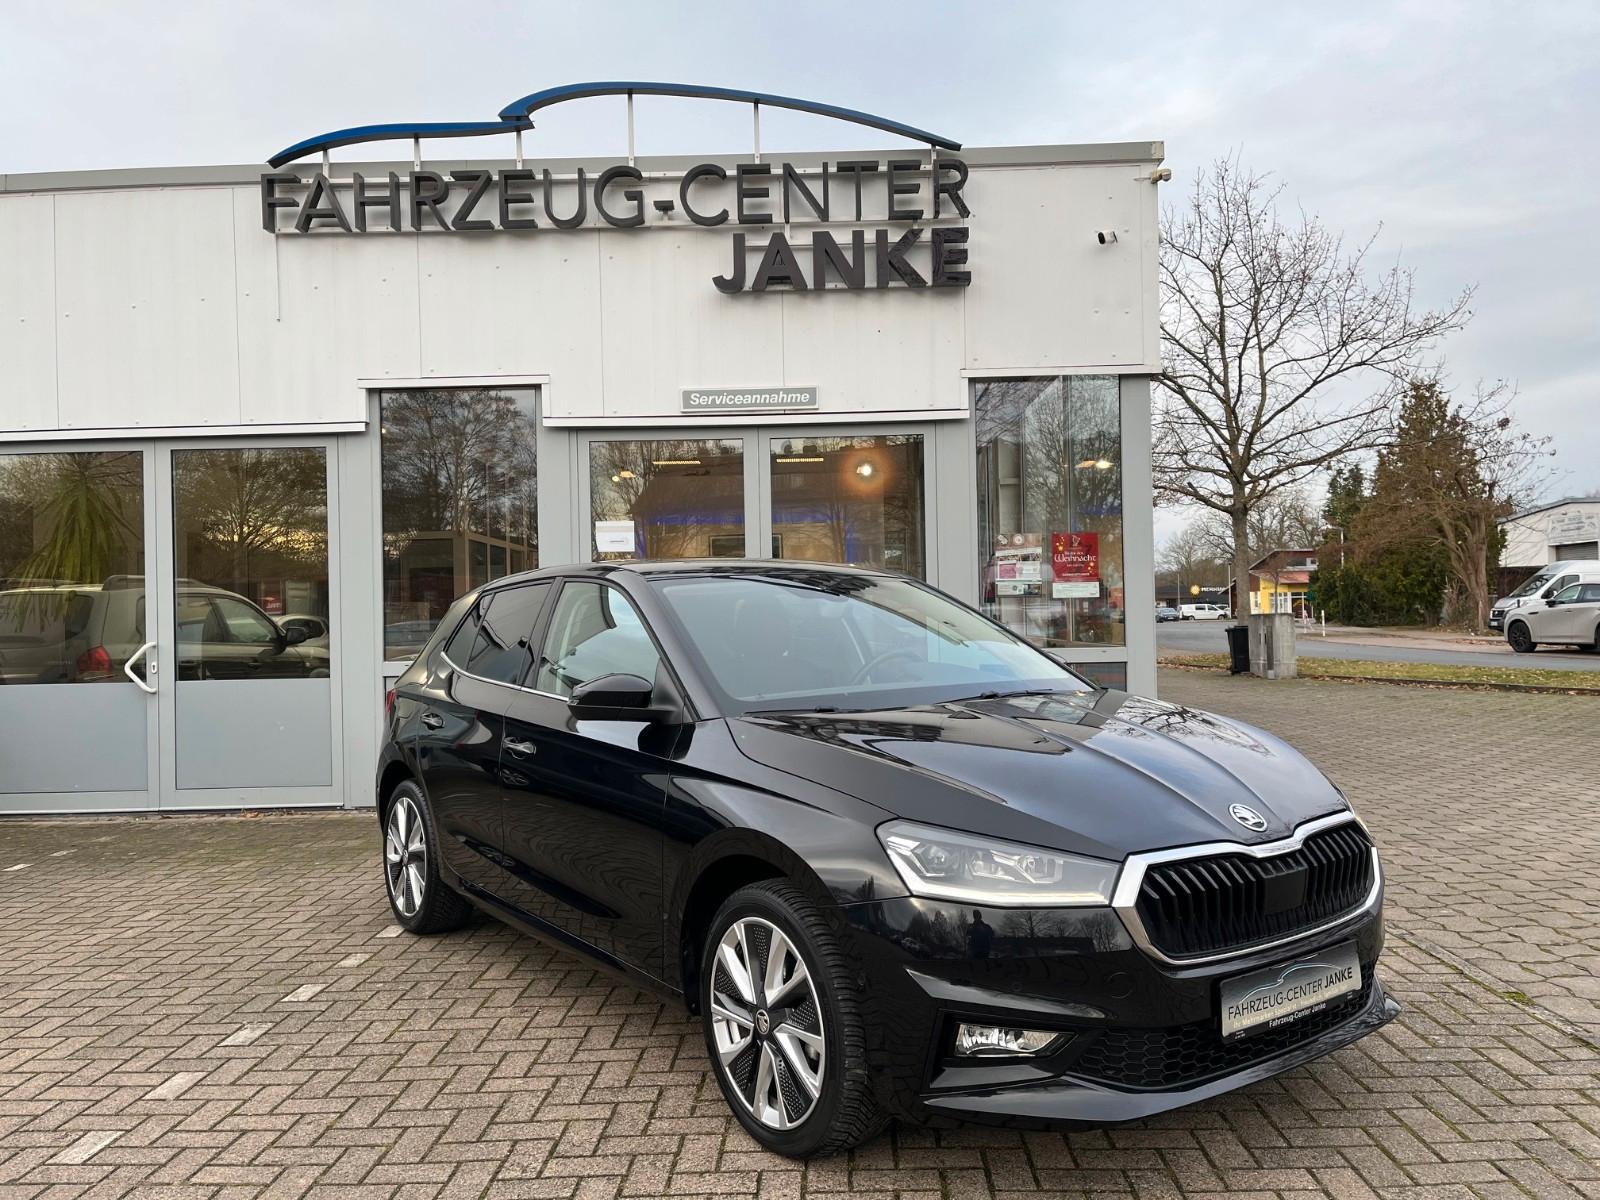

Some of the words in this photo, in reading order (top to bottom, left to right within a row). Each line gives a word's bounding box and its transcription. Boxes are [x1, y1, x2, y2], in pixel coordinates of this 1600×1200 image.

[261, 159, 969, 233] FAHRZEUG-CENTER
[713, 227, 971, 294] JANKE
[690, 391, 810, 406] Serviceannahme
[1228, 980, 1323, 1020] FAHRZEUG-CENTER
[1324, 966, 1353, 989] JANKE
[1269, 1008, 1312, 1028] Fahrzeug-Center
[1312, 1002, 1326, 1013] Janke
